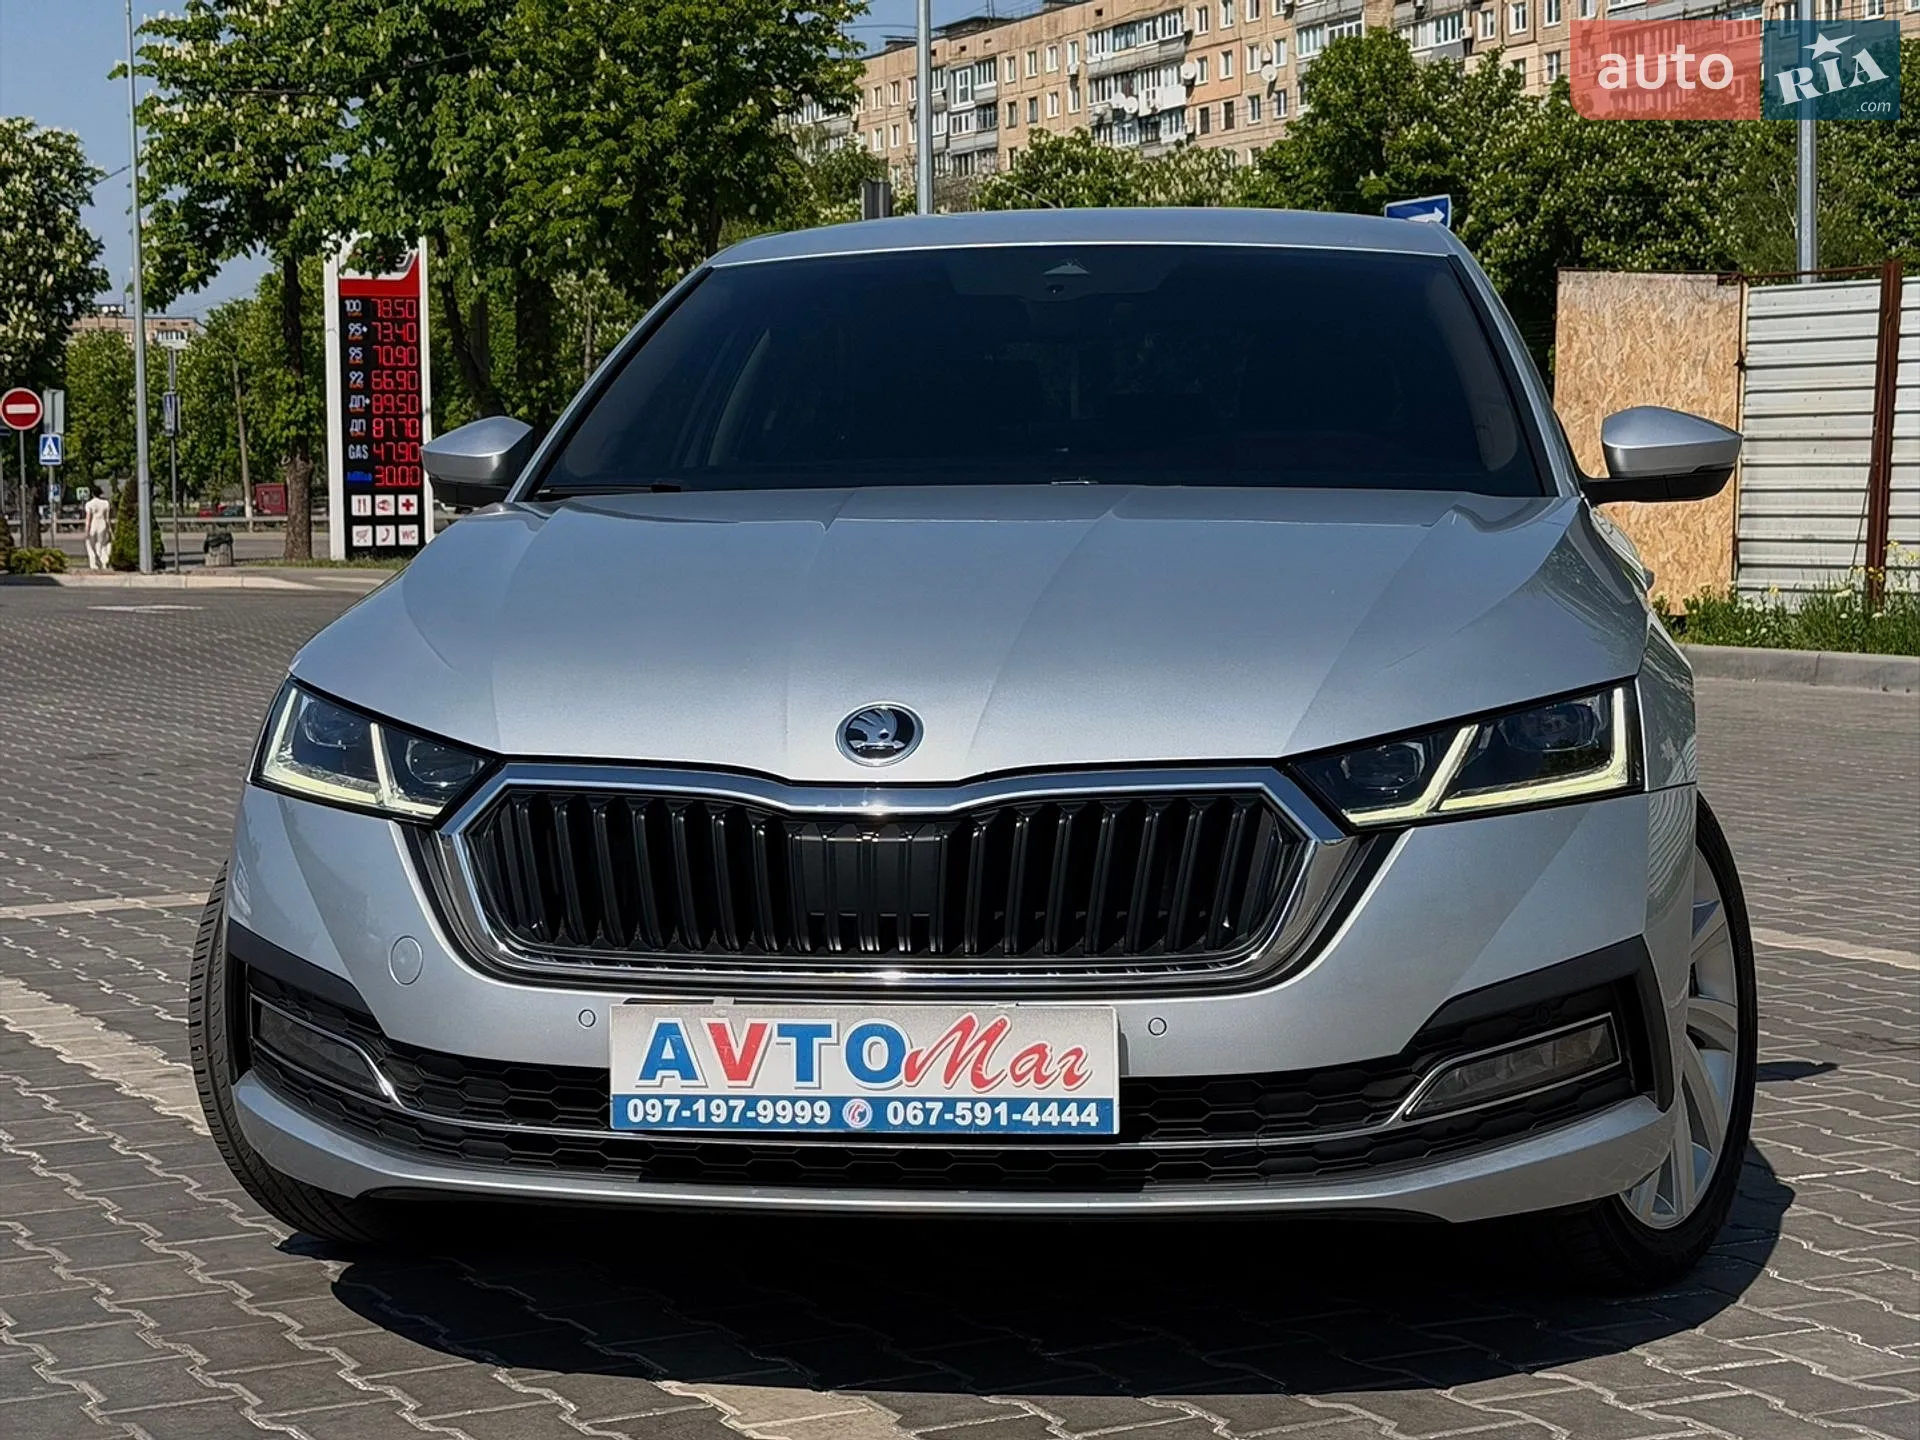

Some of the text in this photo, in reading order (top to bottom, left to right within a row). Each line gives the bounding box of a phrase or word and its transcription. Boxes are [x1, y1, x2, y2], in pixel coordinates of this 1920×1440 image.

[348, 443, 369, 460] GAS
[402, 530, 416, 540] WC
[626, 1099, 1099, 1128] 097-197-9999 067-591-4444
